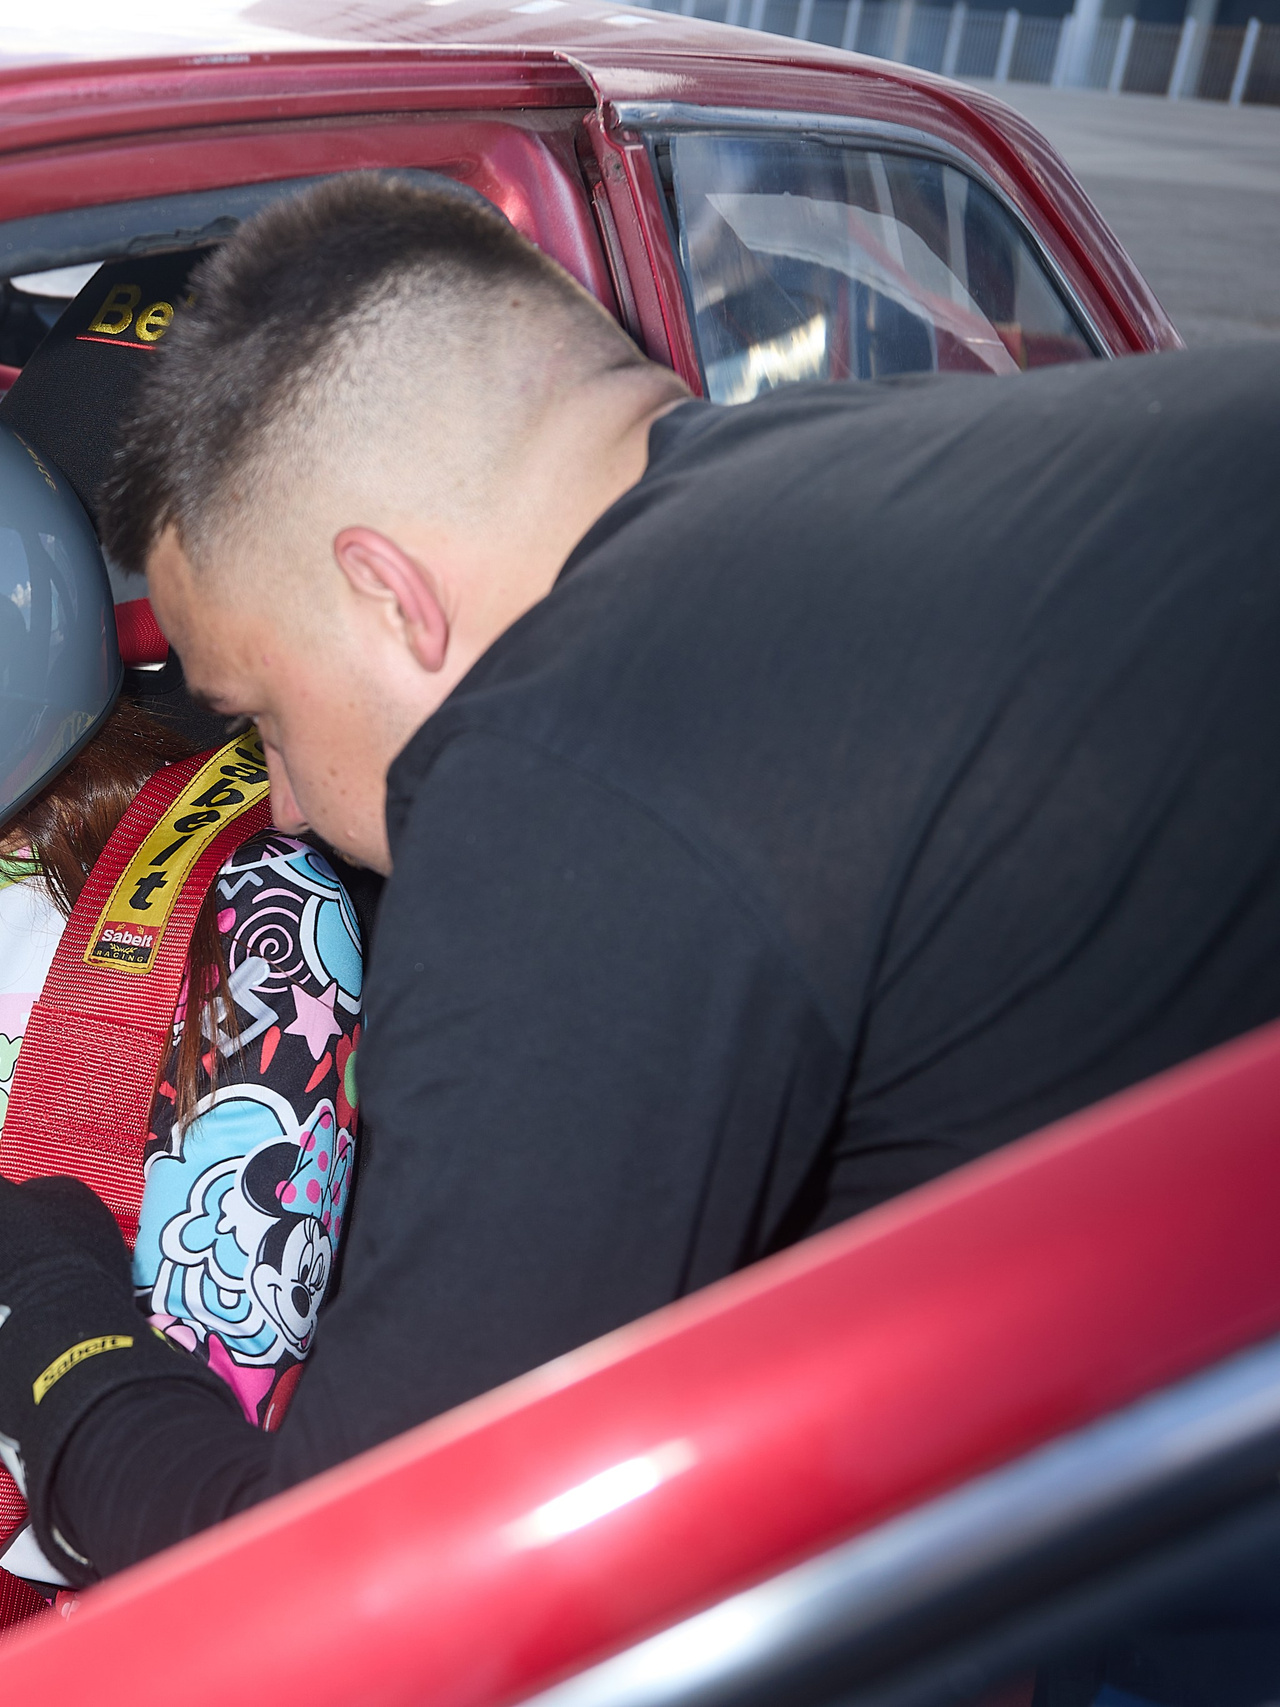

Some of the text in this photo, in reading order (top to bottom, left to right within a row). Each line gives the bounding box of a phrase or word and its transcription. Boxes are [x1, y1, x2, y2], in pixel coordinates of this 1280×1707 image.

[87, 284, 196, 342] Be
[101, 929, 153, 947] Sabelt
[96, 950, 144, 963] RACING
[42, 1337, 120, 1391] Sabelt
